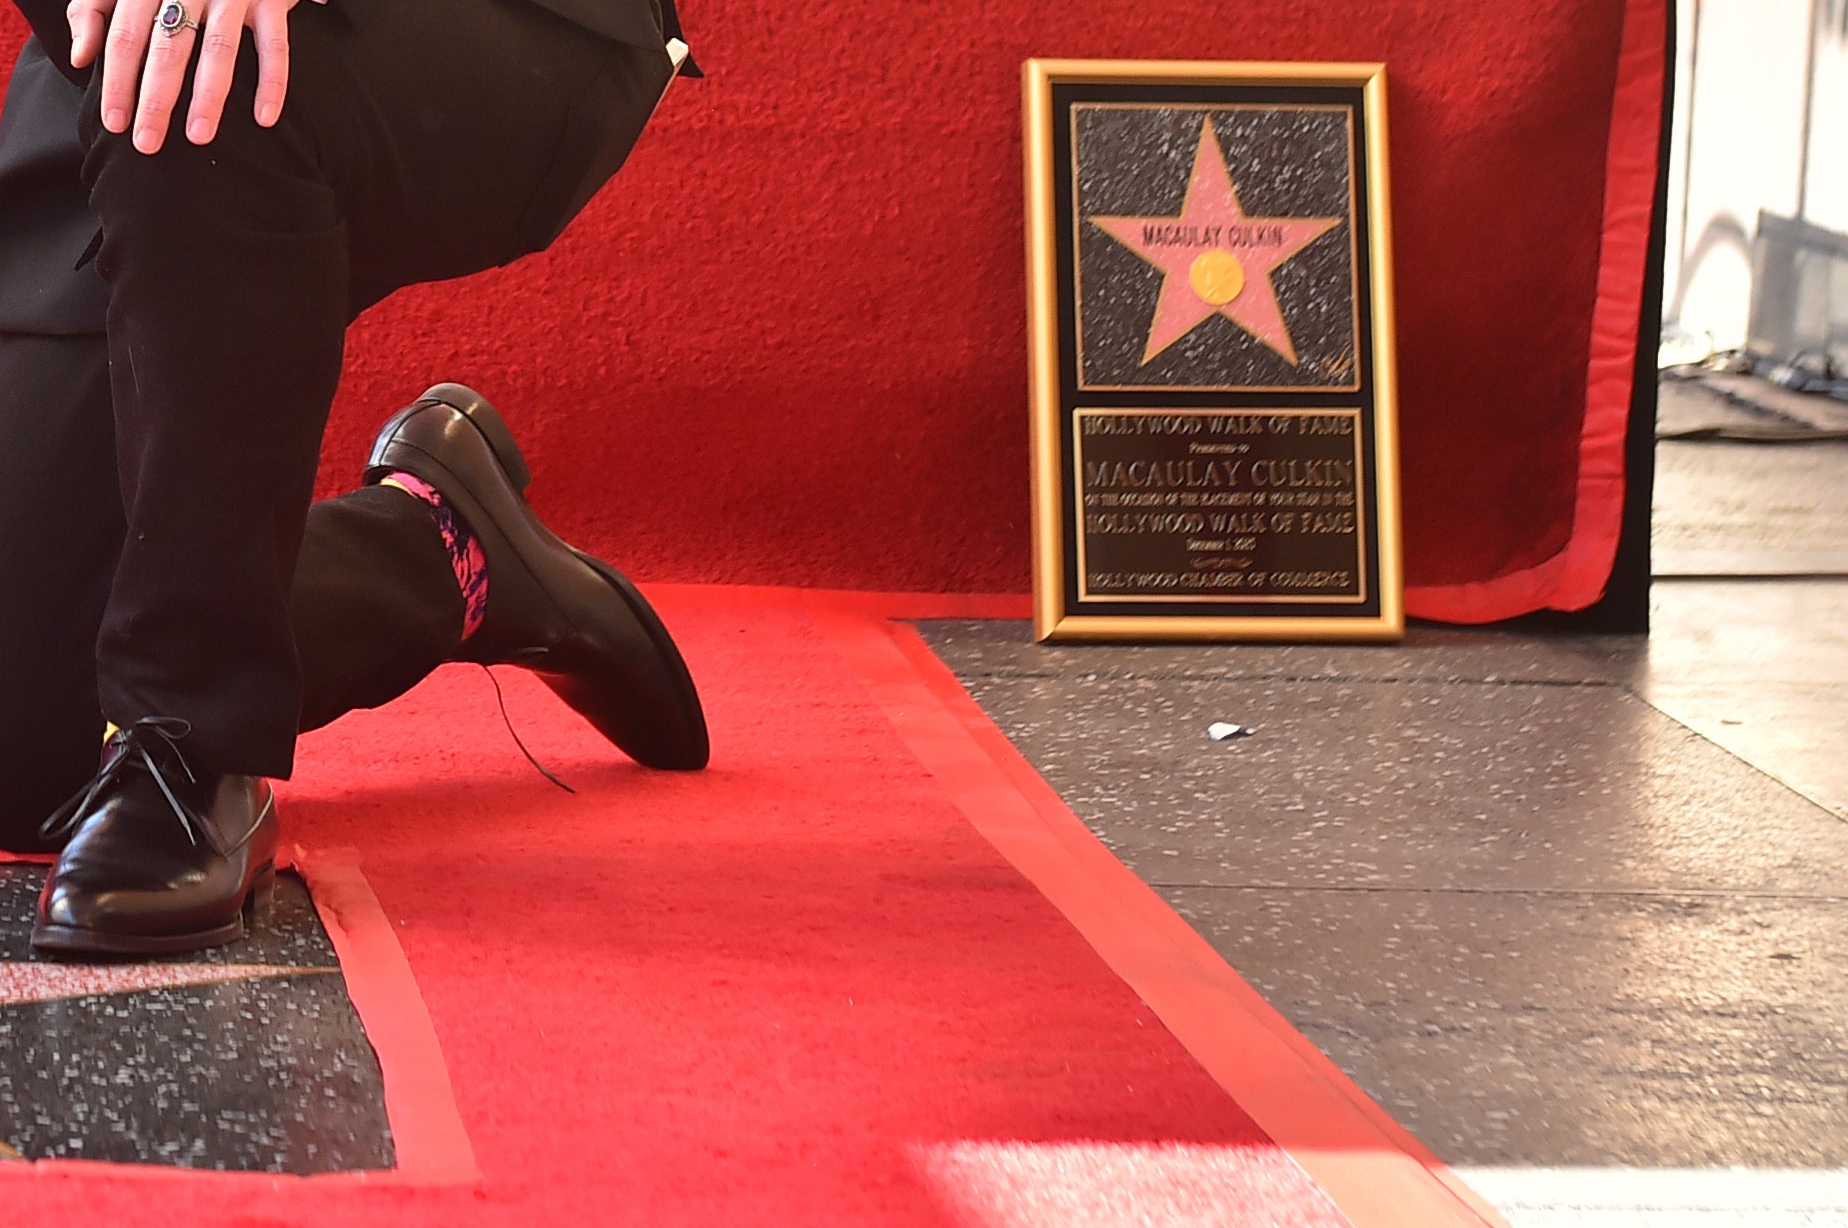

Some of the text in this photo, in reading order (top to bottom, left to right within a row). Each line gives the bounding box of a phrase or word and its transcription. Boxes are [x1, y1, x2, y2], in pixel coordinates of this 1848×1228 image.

[1142, 225, 1283, 248] MACAULAY CULKIN
[1084, 416, 1353, 435] HOLLYWOOD WALK OF FAME
[1086, 459, 1352, 487] MACAULAY CULKIN
[1086, 513, 1355, 534] HOLLYWOOD WALK OF FAME
[1088, 571, 1350, 588] HOLLYWOOD CHAMBER OF COMMERCE
